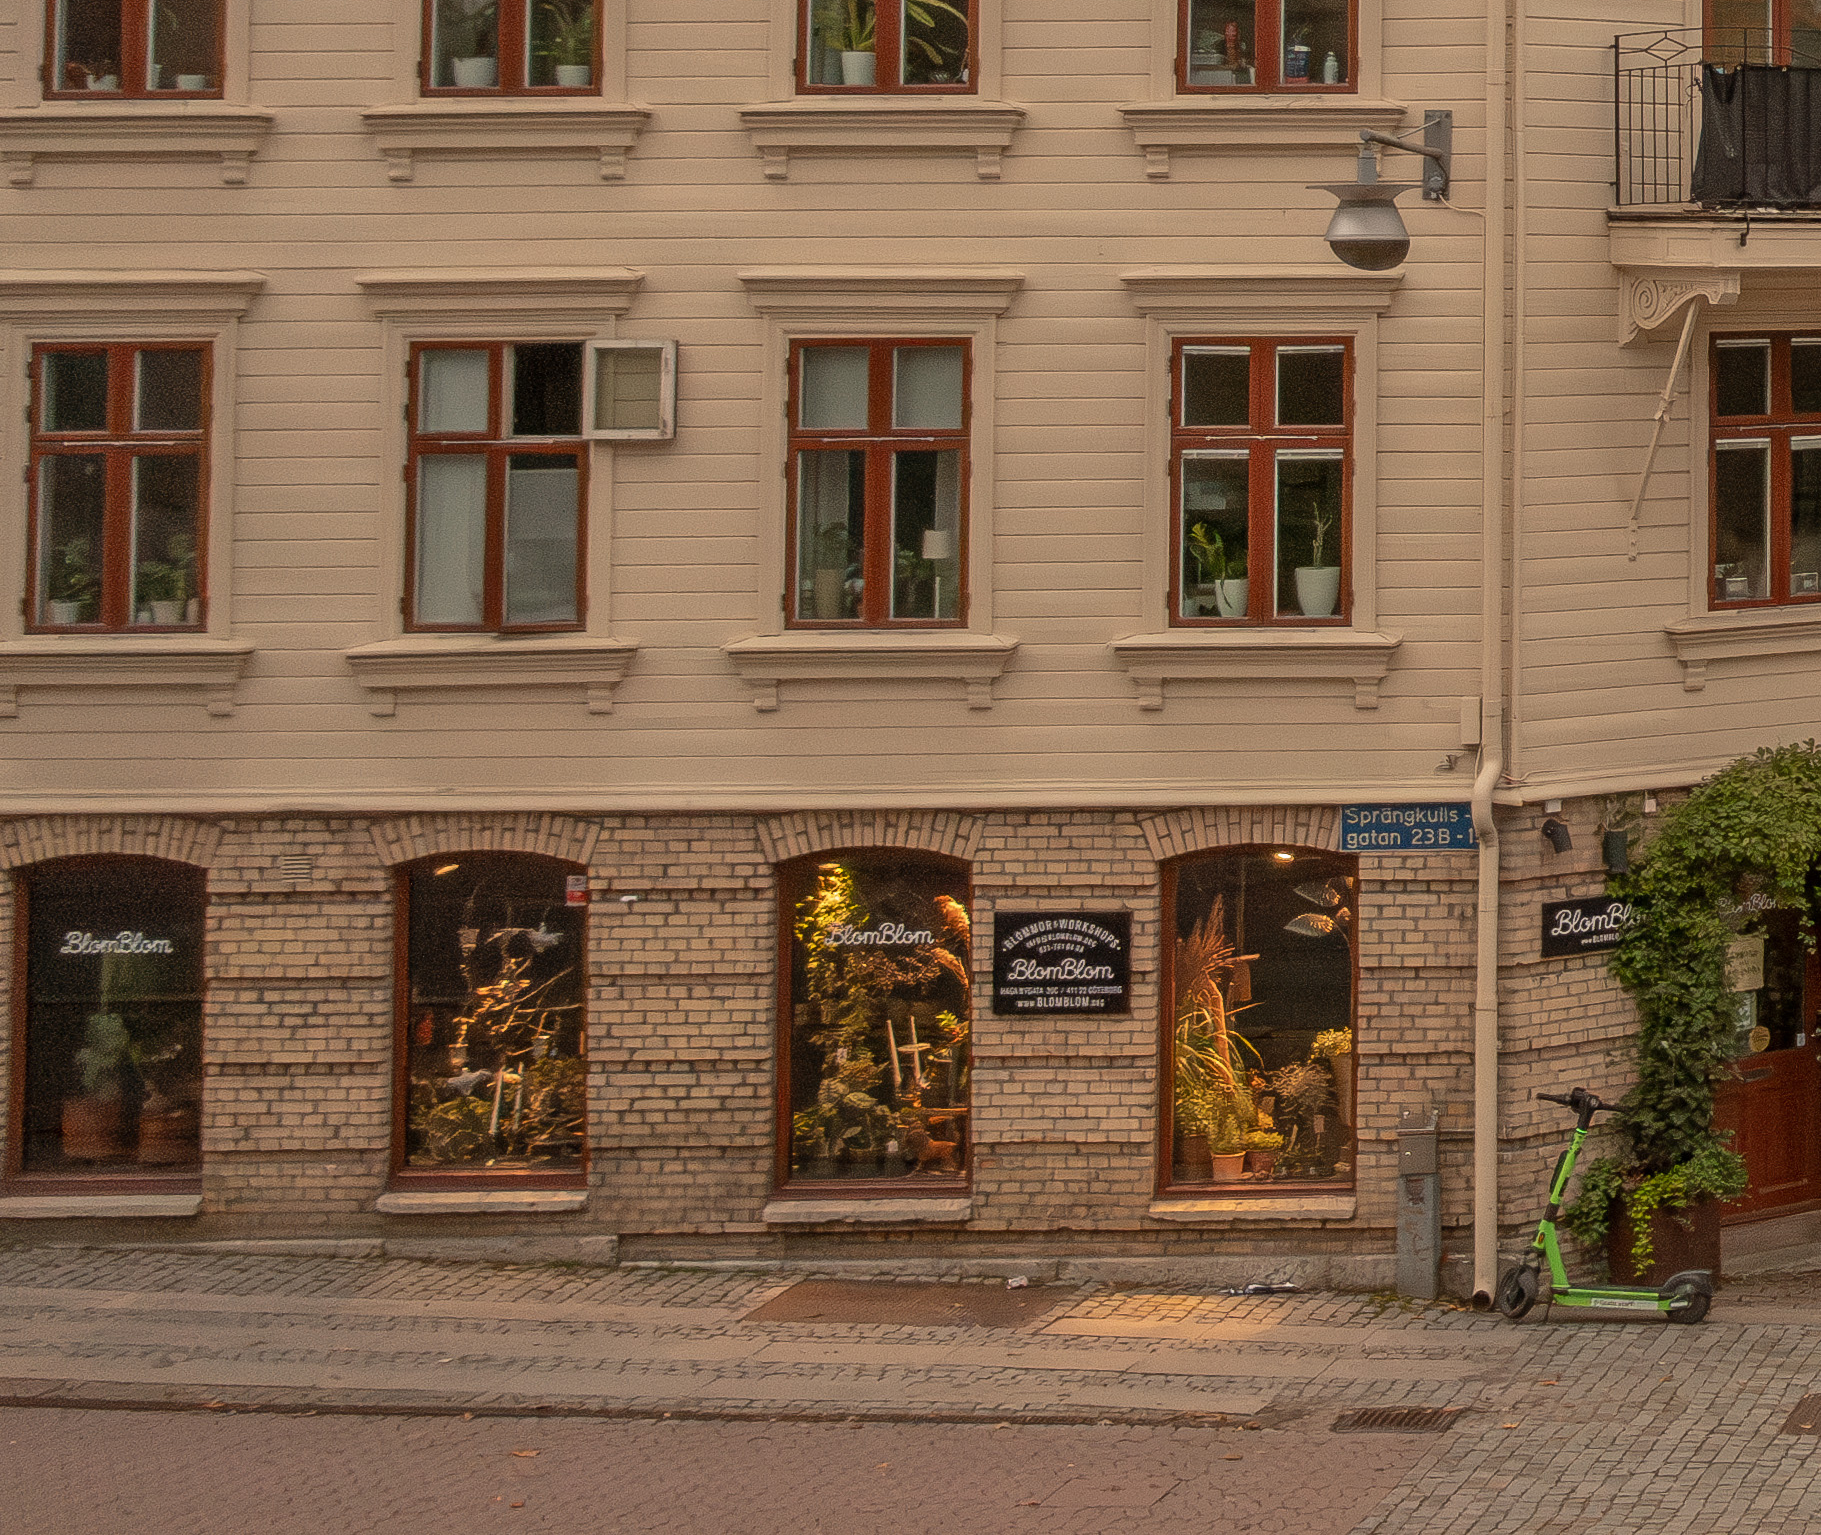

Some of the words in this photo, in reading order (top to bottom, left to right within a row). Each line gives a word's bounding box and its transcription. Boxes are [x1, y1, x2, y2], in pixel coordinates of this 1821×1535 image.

[1347, 829, 1401, 849] gatan
[59, 930, 174, 954] BlomBlom
[824, 922, 935, 946] BlomBlom
[1008, 957, 1115, 980] BlomBlom
